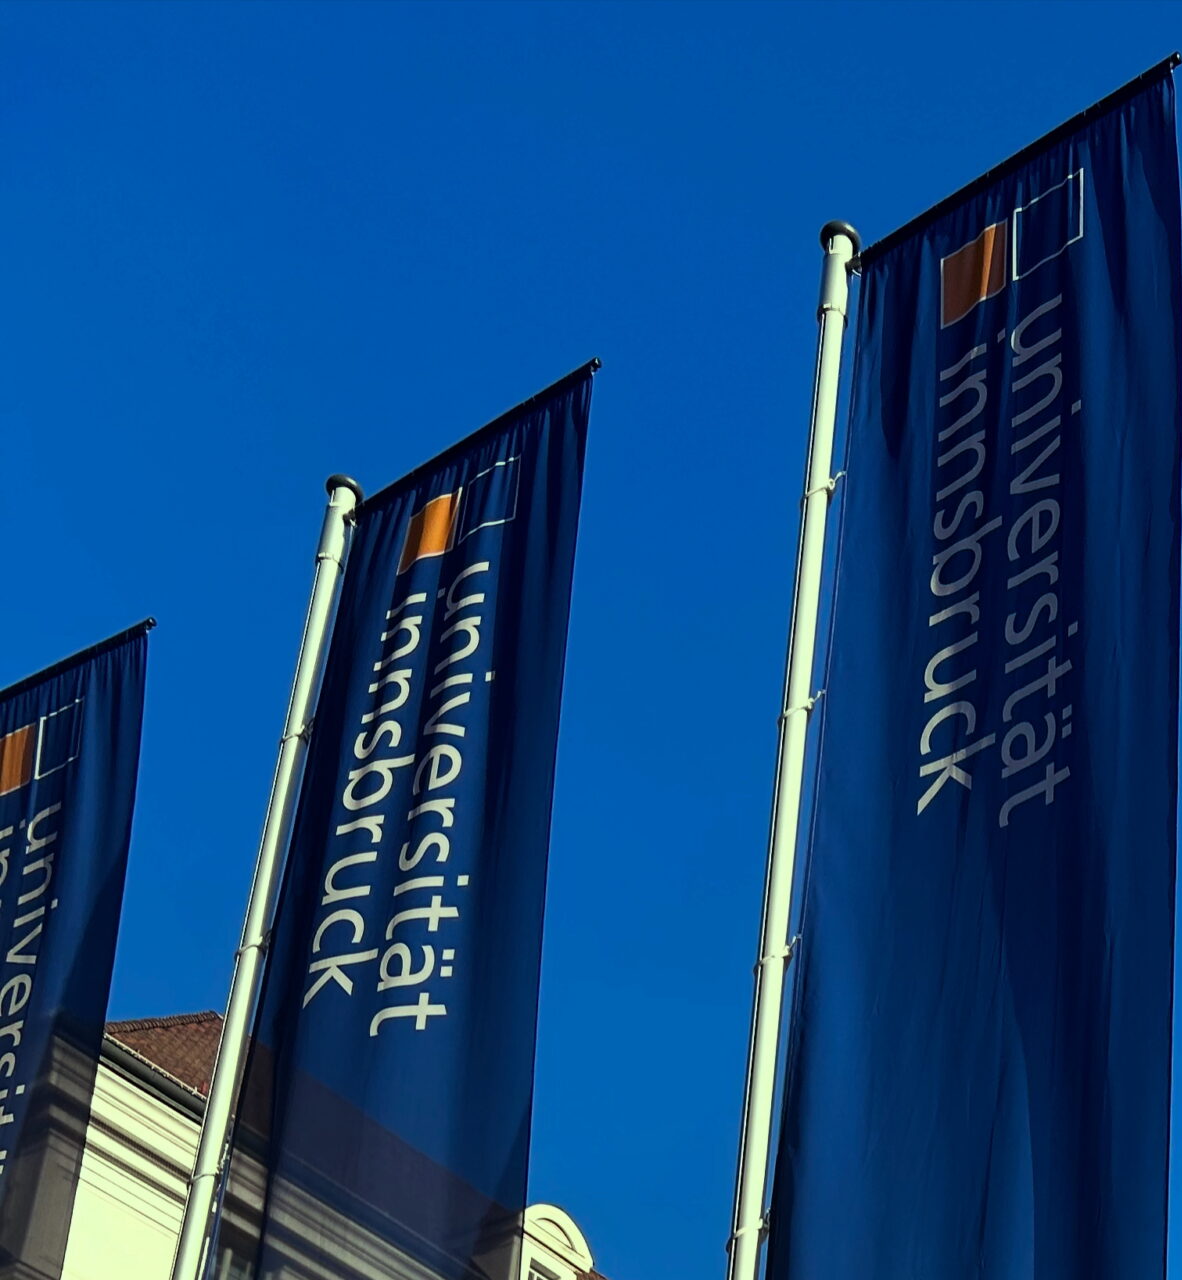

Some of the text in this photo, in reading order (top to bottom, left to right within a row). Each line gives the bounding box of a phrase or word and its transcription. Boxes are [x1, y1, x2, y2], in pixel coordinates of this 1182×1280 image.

[302, 572, 448, 1009] innsbruck
[368, 560, 496, 1037] universität
[917, 331, 1004, 815] innsbruck
[1001, 293, 1082, 828] universität
